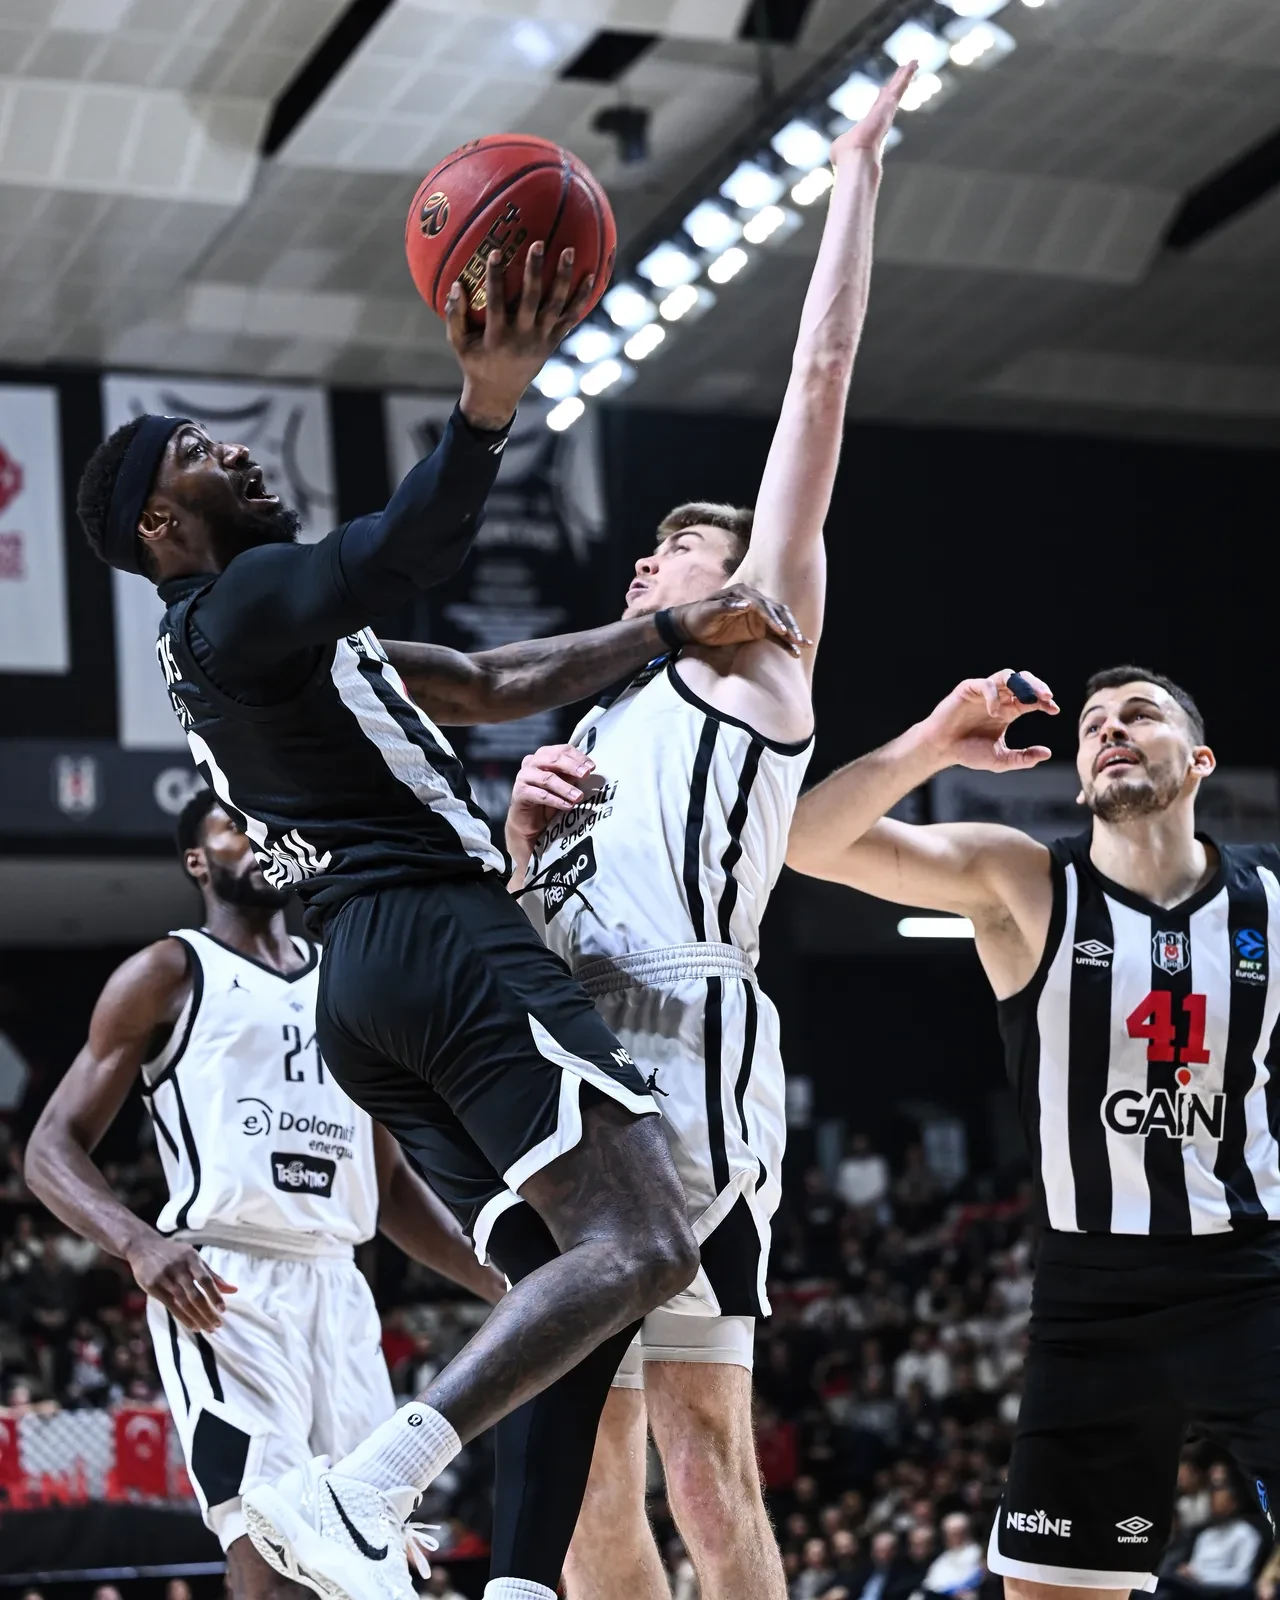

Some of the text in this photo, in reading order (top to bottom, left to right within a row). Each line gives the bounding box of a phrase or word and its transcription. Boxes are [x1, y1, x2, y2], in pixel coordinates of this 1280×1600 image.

[456, 202, 522, 296] EGACY
[559, 806, 613, 851] energia
[1075, 957, 1110, 968] umbro
[1235, 969, 1266, 981] EuroCup
[1238, 959, 1262, 970] BKT
[1126, 990, 1210, 1064] 41
[282, 1024, 324, 1085] 21
[279, 1112, 355, 1142] Dolomiti
[1102, 1086, 1226, 1140] GAIN
[308, 1140, 353, 1160] energia
